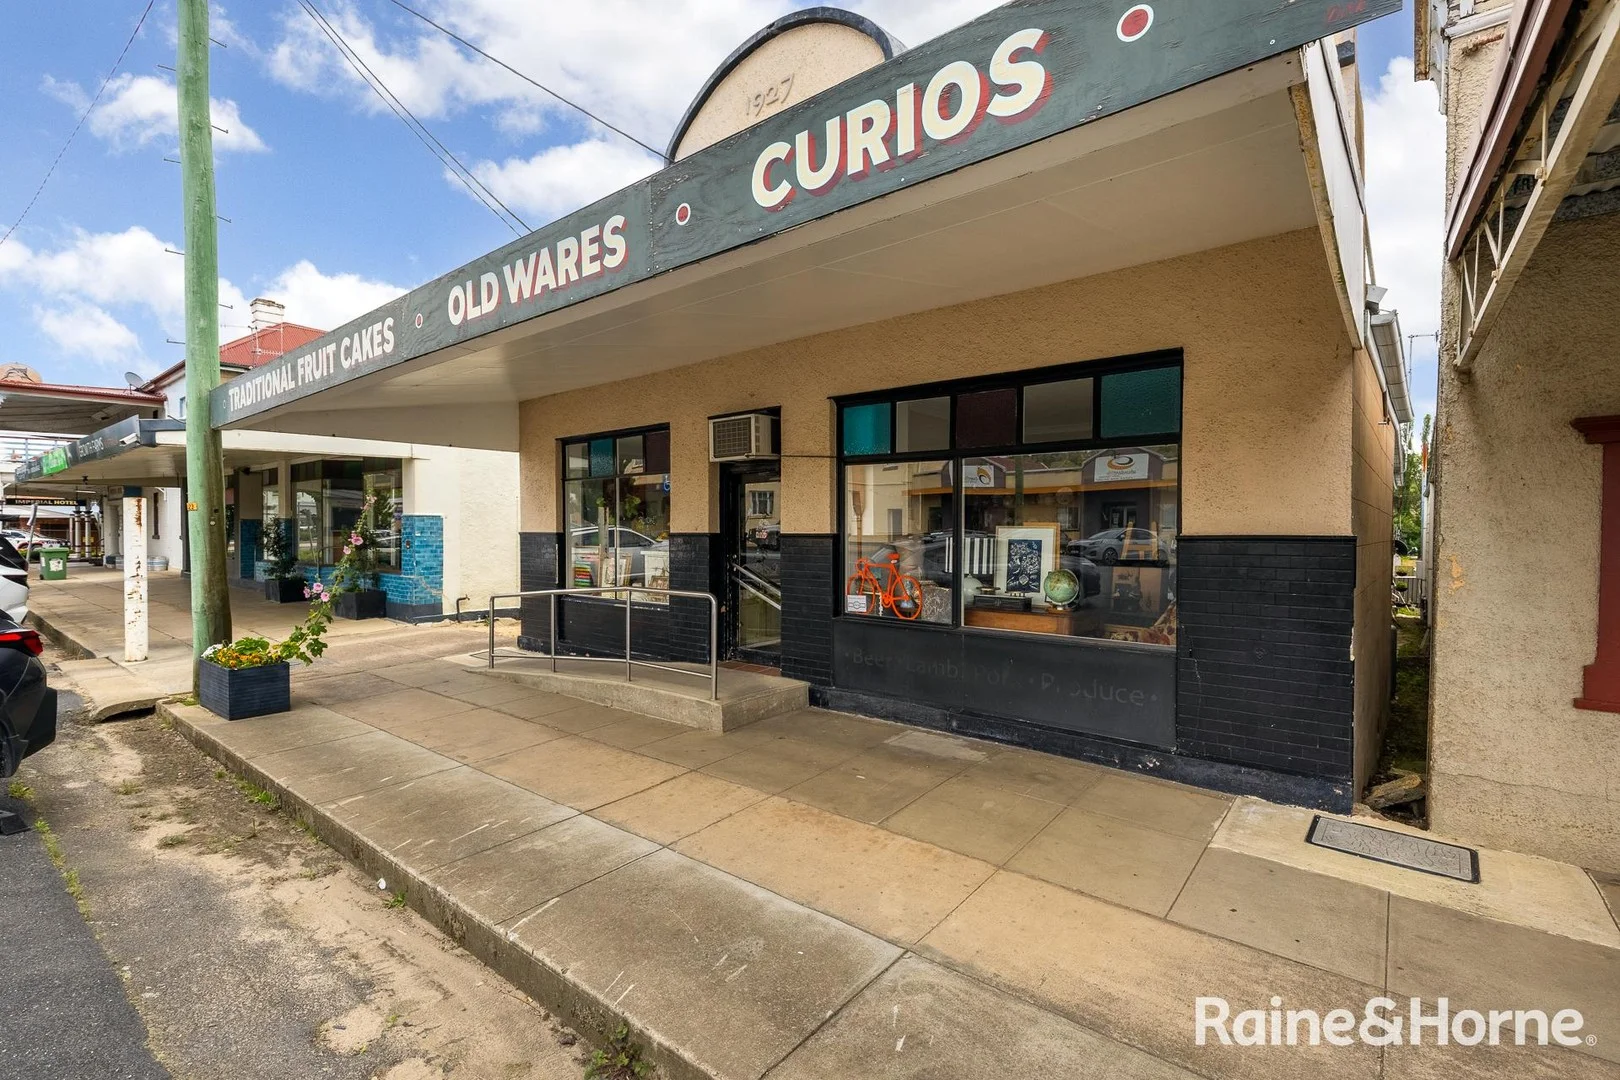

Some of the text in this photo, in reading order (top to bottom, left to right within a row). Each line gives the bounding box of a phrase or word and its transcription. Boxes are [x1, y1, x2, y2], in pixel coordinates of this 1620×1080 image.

[746, 73, 794, 117] 1927
[751, 28, 1050, 211] CURIOS
[448, 214, 627, 326] OLD WARES
[228, 316, 395, 412] TRADITIONAL FRUIT CAKES
[905, 655, 959, 678] Lamb
